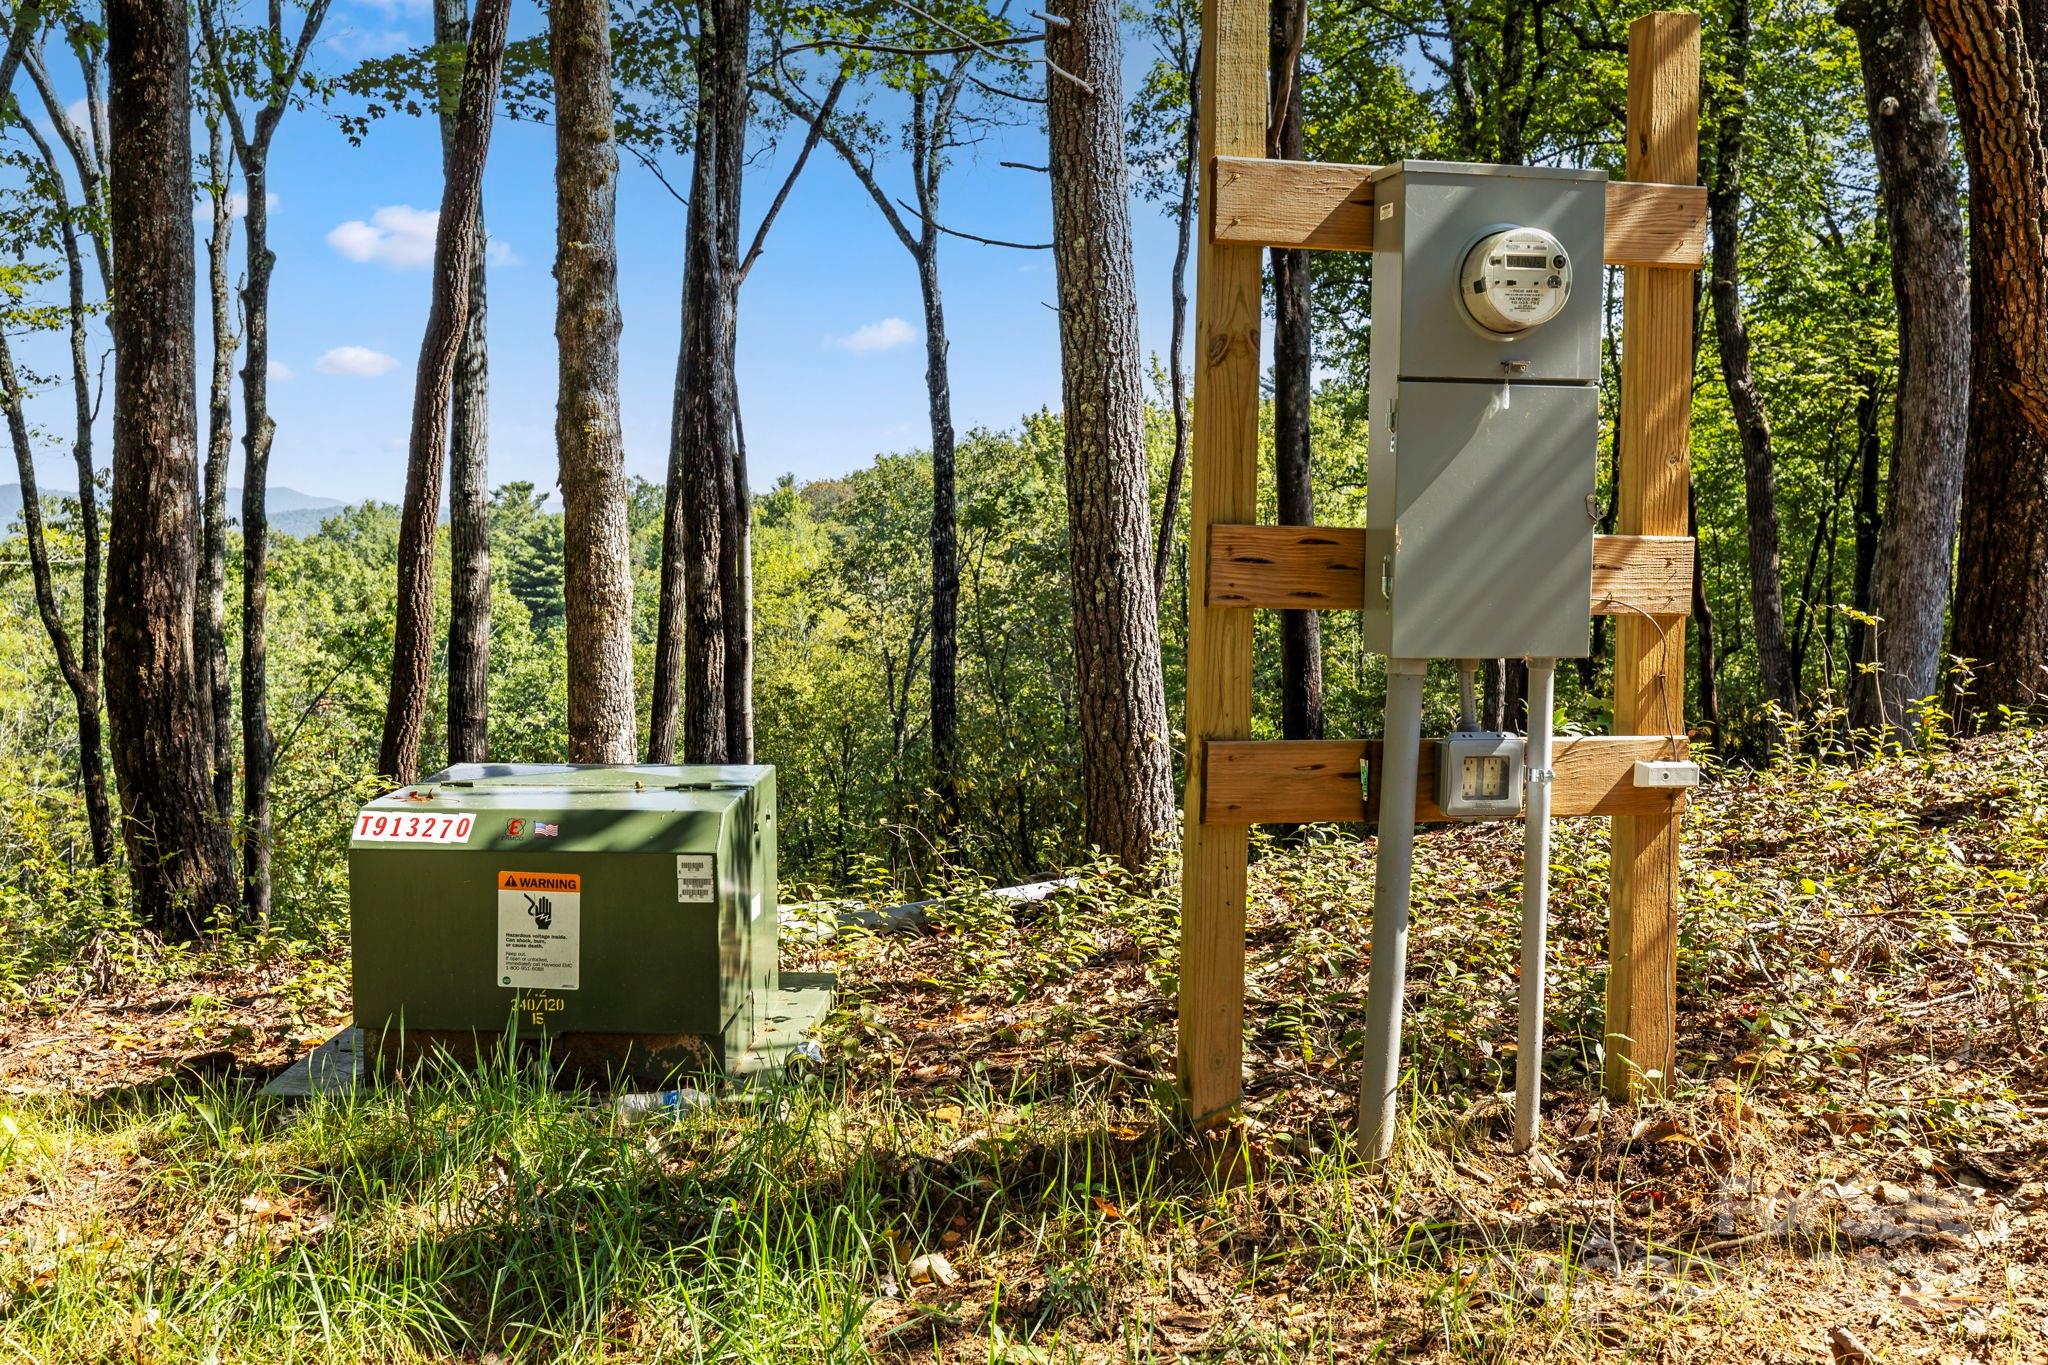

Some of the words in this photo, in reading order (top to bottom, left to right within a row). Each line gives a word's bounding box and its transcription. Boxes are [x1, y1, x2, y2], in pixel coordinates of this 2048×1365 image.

[359, 815, 471, 839] T913270
[520, 878, 577, 890] WARNING
[510, 998, 565, 1011] 240/120
[532, 1012, 545, 1025] 15
